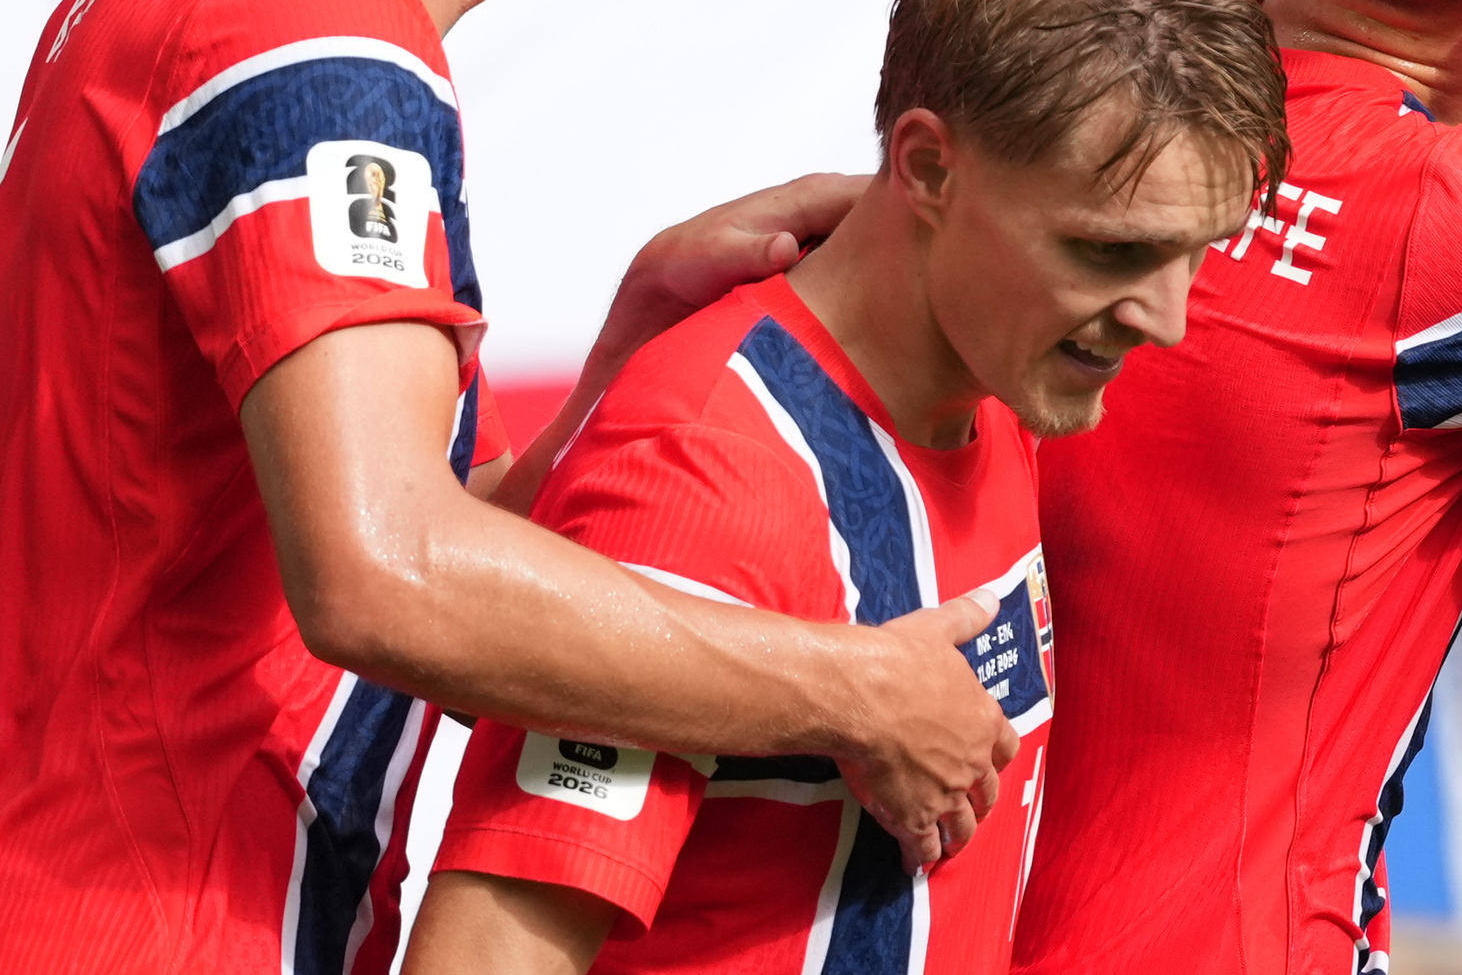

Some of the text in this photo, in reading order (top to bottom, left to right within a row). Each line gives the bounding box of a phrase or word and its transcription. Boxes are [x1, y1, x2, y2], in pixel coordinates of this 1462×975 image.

[351, 253, 405, 272] 2026
[574, 743, 602, 762] FIFA
[551, 761, 613, 785] WORLD CUP
[547, 773, 610, 800] 2026
